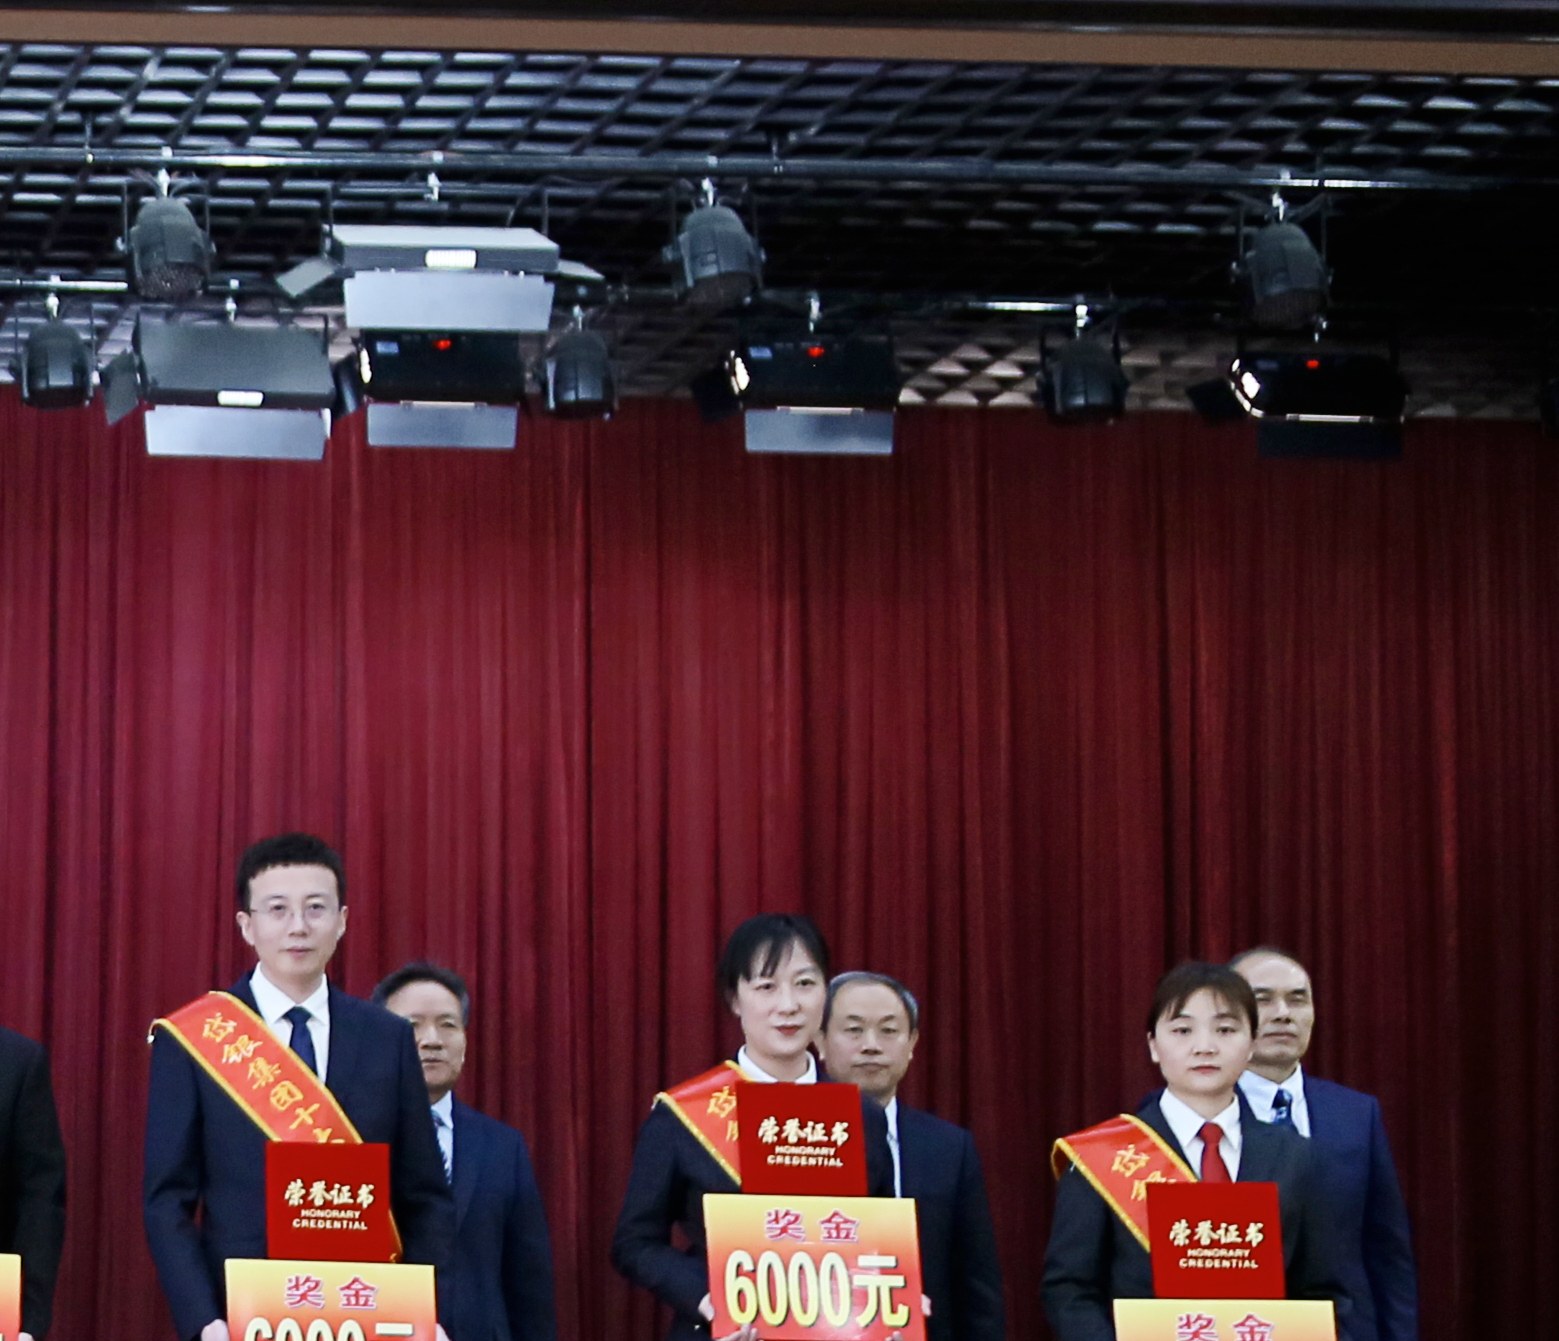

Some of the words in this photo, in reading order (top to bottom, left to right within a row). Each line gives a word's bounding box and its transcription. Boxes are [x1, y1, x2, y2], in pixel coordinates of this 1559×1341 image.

[758, 1116, 849, 1147] 荣誉证书
[767, 1154, 843, 1167] CREDENTIAL
[775, 1145, 835, 1156] HONORARY
[284, 1179, 376, 1209] 荣誉证书
[292, 1218, 368, 1230] CREDENTIAL
[301, 1209, 361, 1219] HONORARY
[765, 1208, 861, 1243] 奖金
[1169, 1219, 1265, 1247] 荣誉证书
[1187, 1248, 1251, 1258] HONORARY
[1179, 1258, 1259, 1269] CREDENTIAL
[284, 1274, 378, 1311] 奖金
[724, 1249, 911, 1328] 6000元
